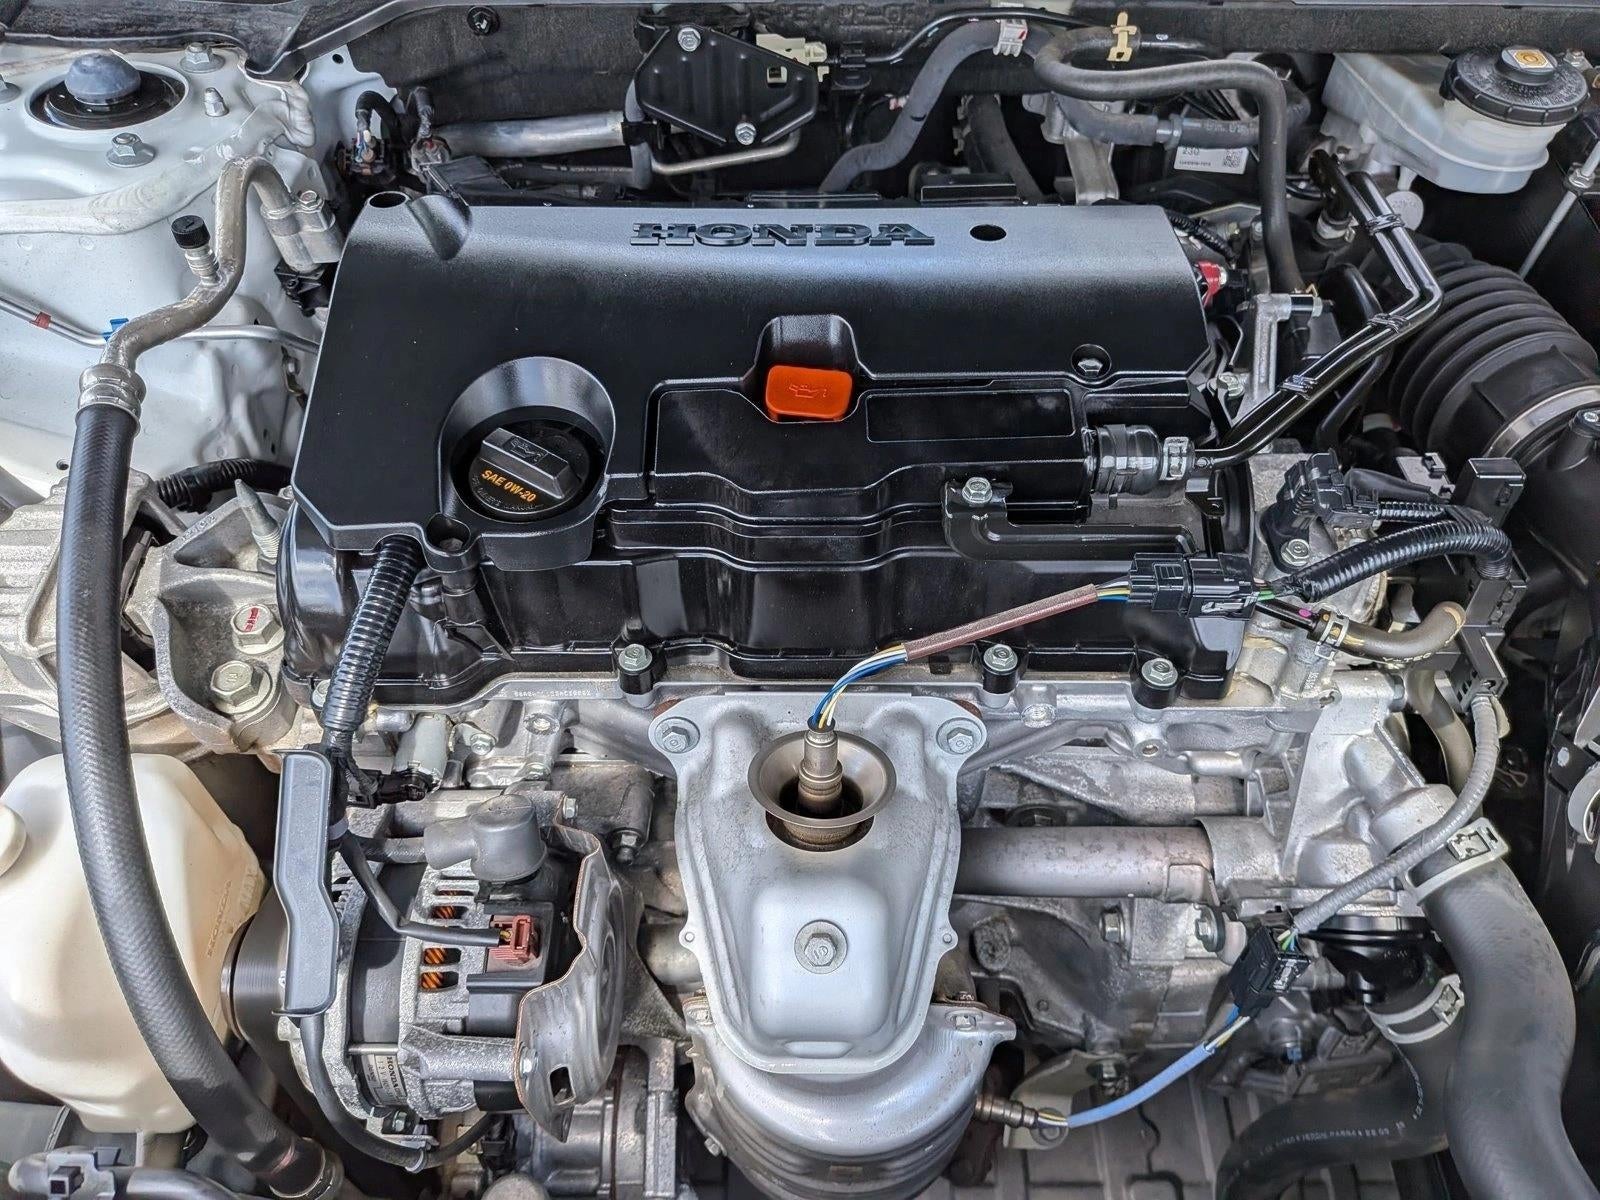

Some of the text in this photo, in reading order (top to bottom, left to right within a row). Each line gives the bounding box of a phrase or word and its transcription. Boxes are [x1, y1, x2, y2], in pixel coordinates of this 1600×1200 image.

[630, 222, 936, 247] HONDA
[481, 469, 507, 487] SAE
[503, 481, 537, 503] 0W-20
[386, 1056, 400, 1088] HONDA
